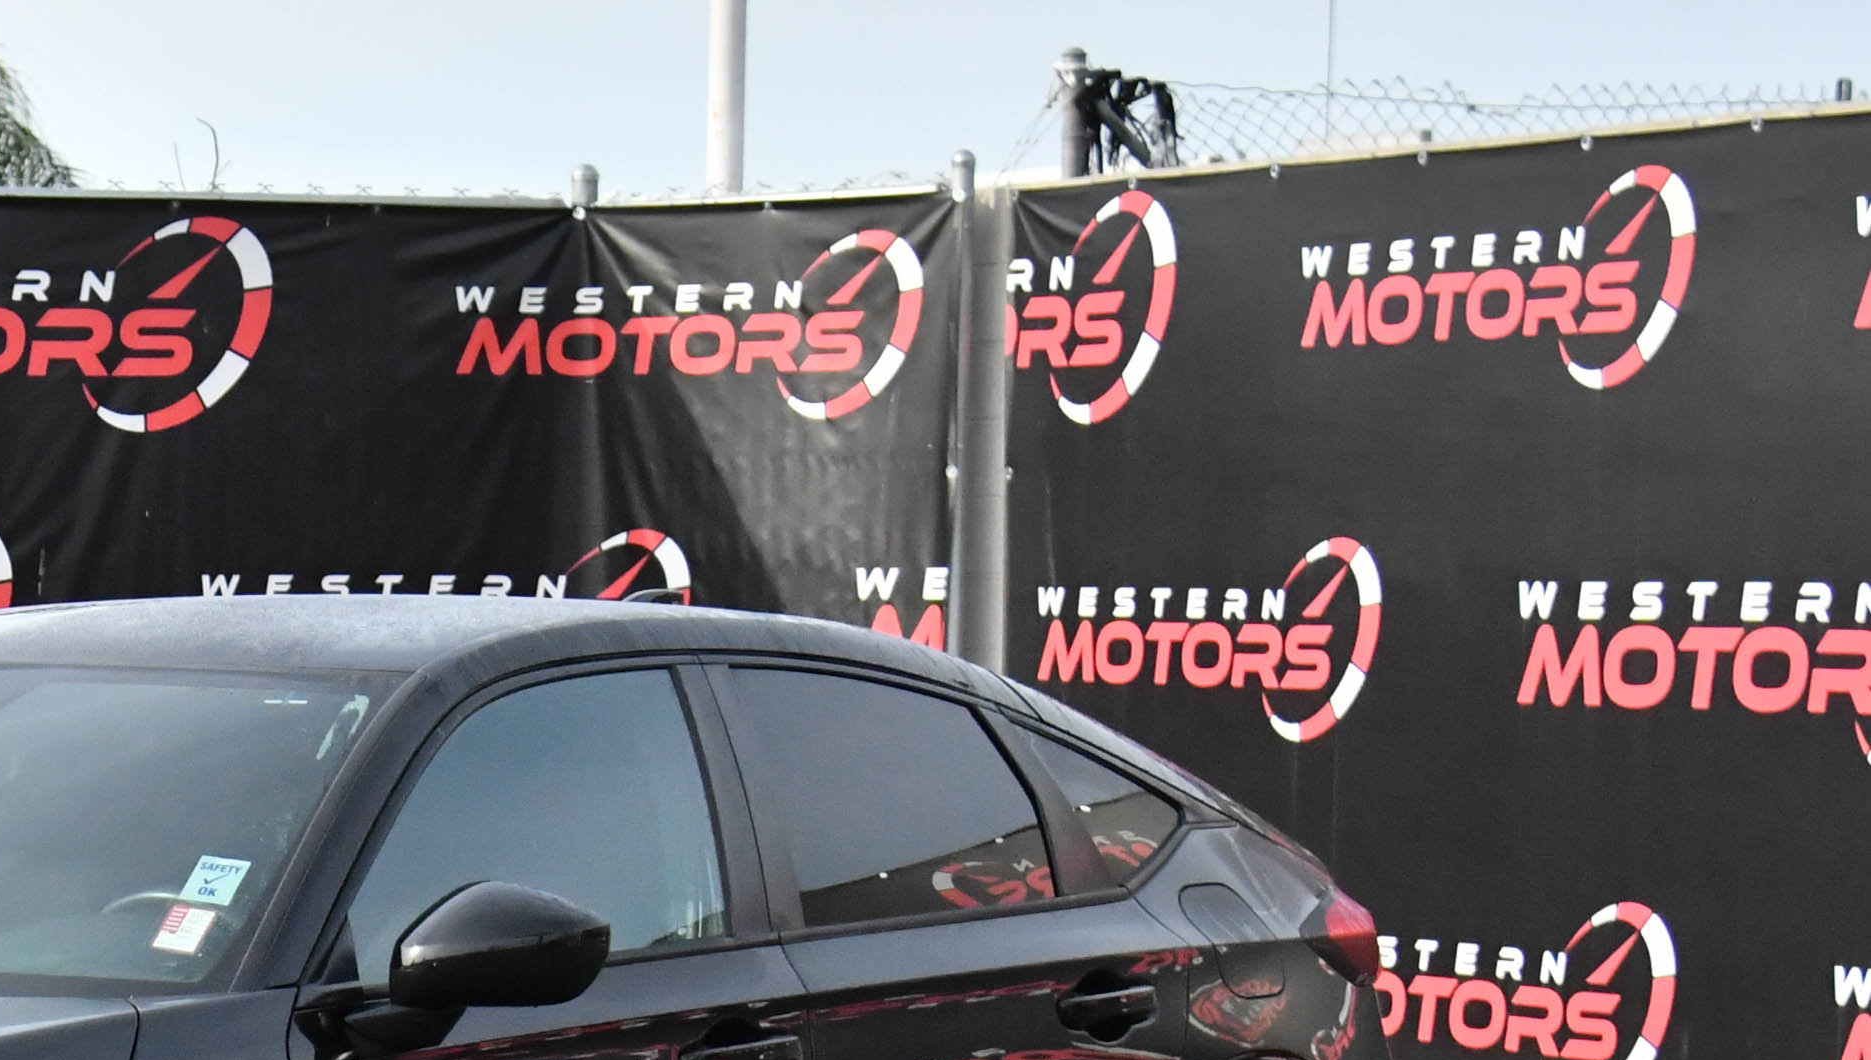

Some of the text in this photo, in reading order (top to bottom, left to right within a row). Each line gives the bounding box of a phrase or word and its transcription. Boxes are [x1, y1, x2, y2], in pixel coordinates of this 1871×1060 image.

[1302, 226, 1585, 279] WESTERN
[456, 280, 803, 314] WESTERN
[1302, 261, 1640, 348] MOTORS
[457, 310, 864, 376] MOTORS
[1038, 587, 1285, 619] WESTERN
[1038, 619, 1333, 691] MOTORS
[199, 861, 243, 875] SAFETY
[197, 886, 218, 897] OK
